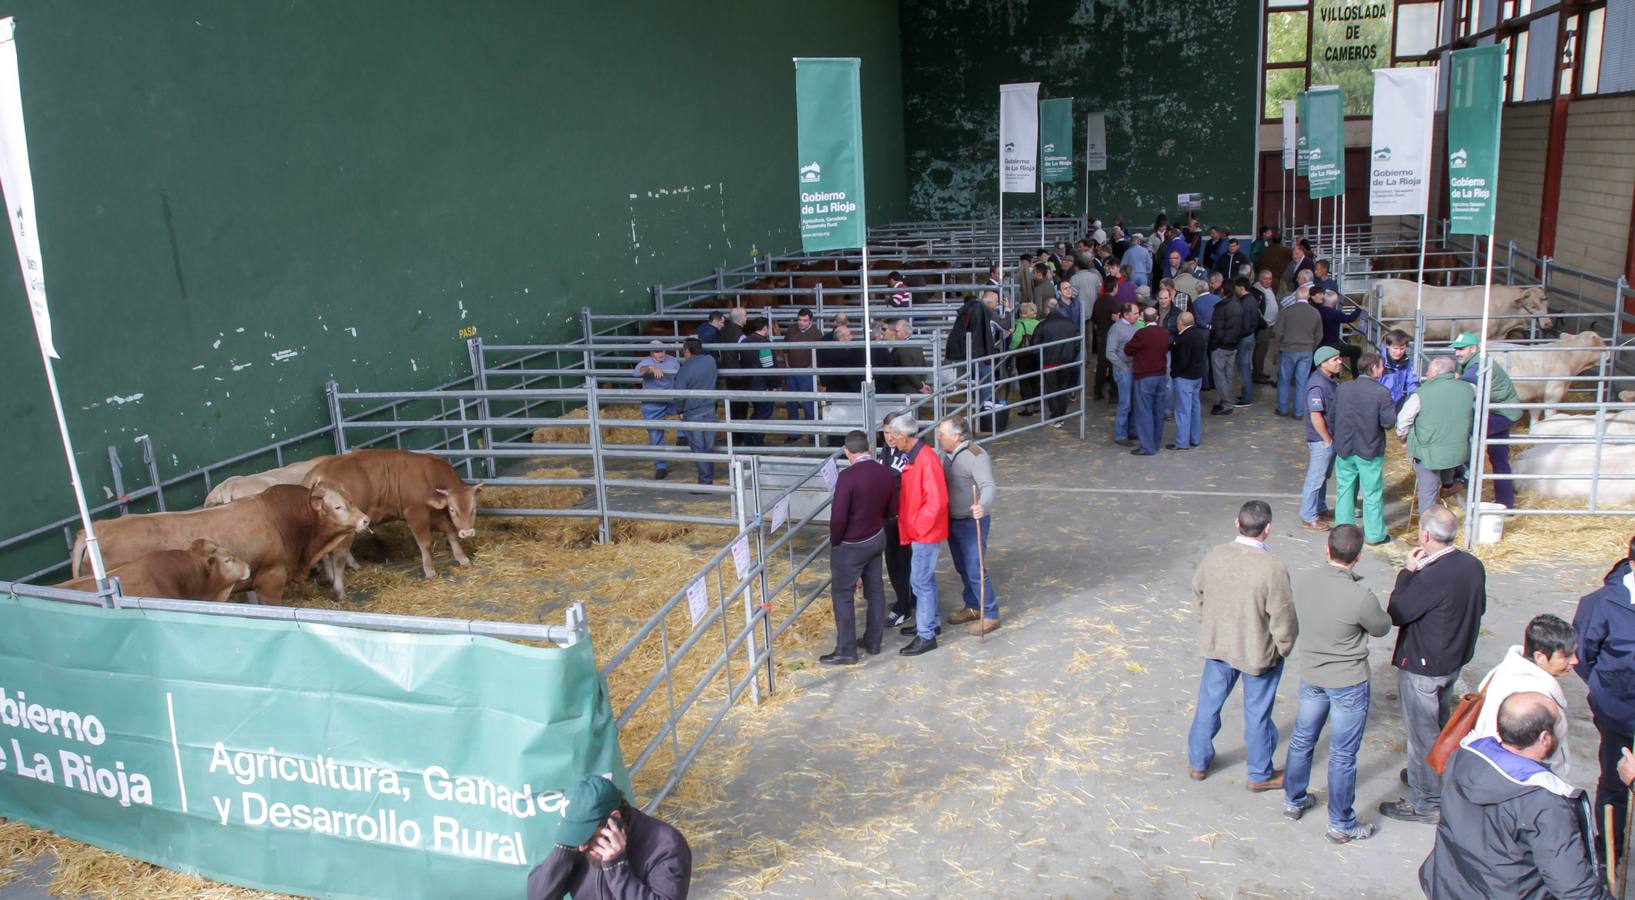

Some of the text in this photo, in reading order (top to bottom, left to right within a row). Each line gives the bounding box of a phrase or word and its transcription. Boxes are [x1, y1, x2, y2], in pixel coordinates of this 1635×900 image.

[1321, 4, 1386, 21] VILLOSLADA
[1346, 26, 1360, 40] DE
[1325, 45, 1377, 62] CAMEROS
[1373, 169, 1414, 177] Gobierno
[1386, 178, 1397, 186] La
[1399, 176, 1422, 187] Rioja
[1451, 177, 1485, 187] Gobierno
[801, 192, 846, 202] Gobierno
[1451, 189, 1461, 198] de
[1462, 188, 1472, 198] La
[801, 201, 855, 215] de La Rioja
[11, 738, 55, 784] La
[58, 749, 153, 807] Rioja
[209, 742, 411, 801] Agricultura,
[212, 792, 528, 865] y Desarrollo Rural
